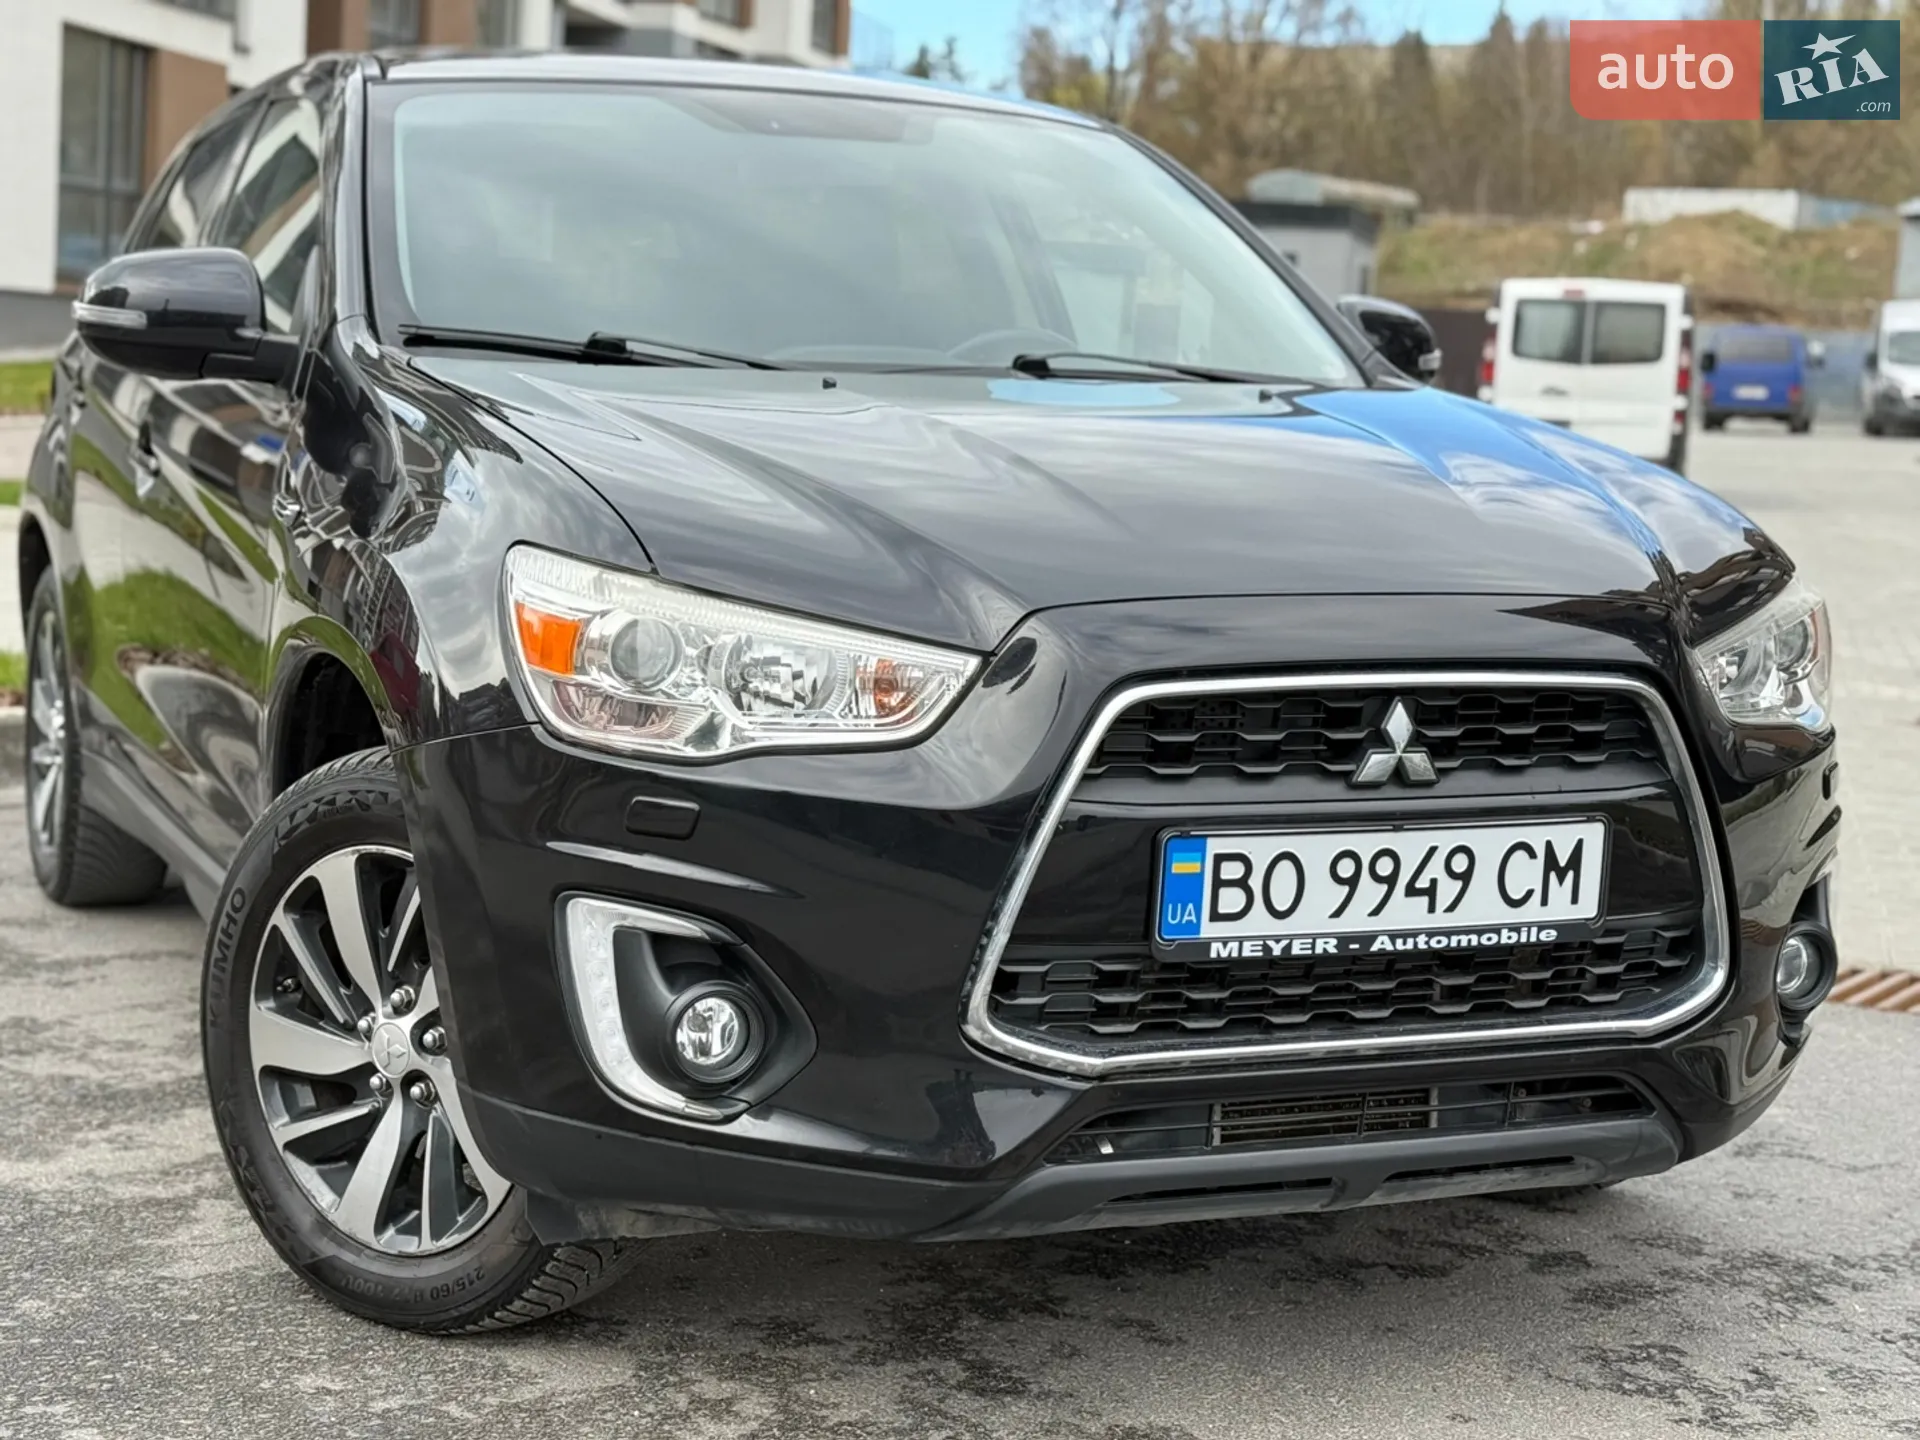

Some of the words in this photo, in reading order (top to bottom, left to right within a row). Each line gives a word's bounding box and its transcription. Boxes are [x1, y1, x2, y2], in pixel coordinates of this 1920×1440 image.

[1208, 850, 1305, 922] BO
[1328, 844, 1476, 919] 9949
[1498, 838, 1585, 909] CM
[1166, 902, 1197, 925] UA
[1209, 938, 1338, 958] MEYER
[1369, 926, 1558, 952] Automobile
